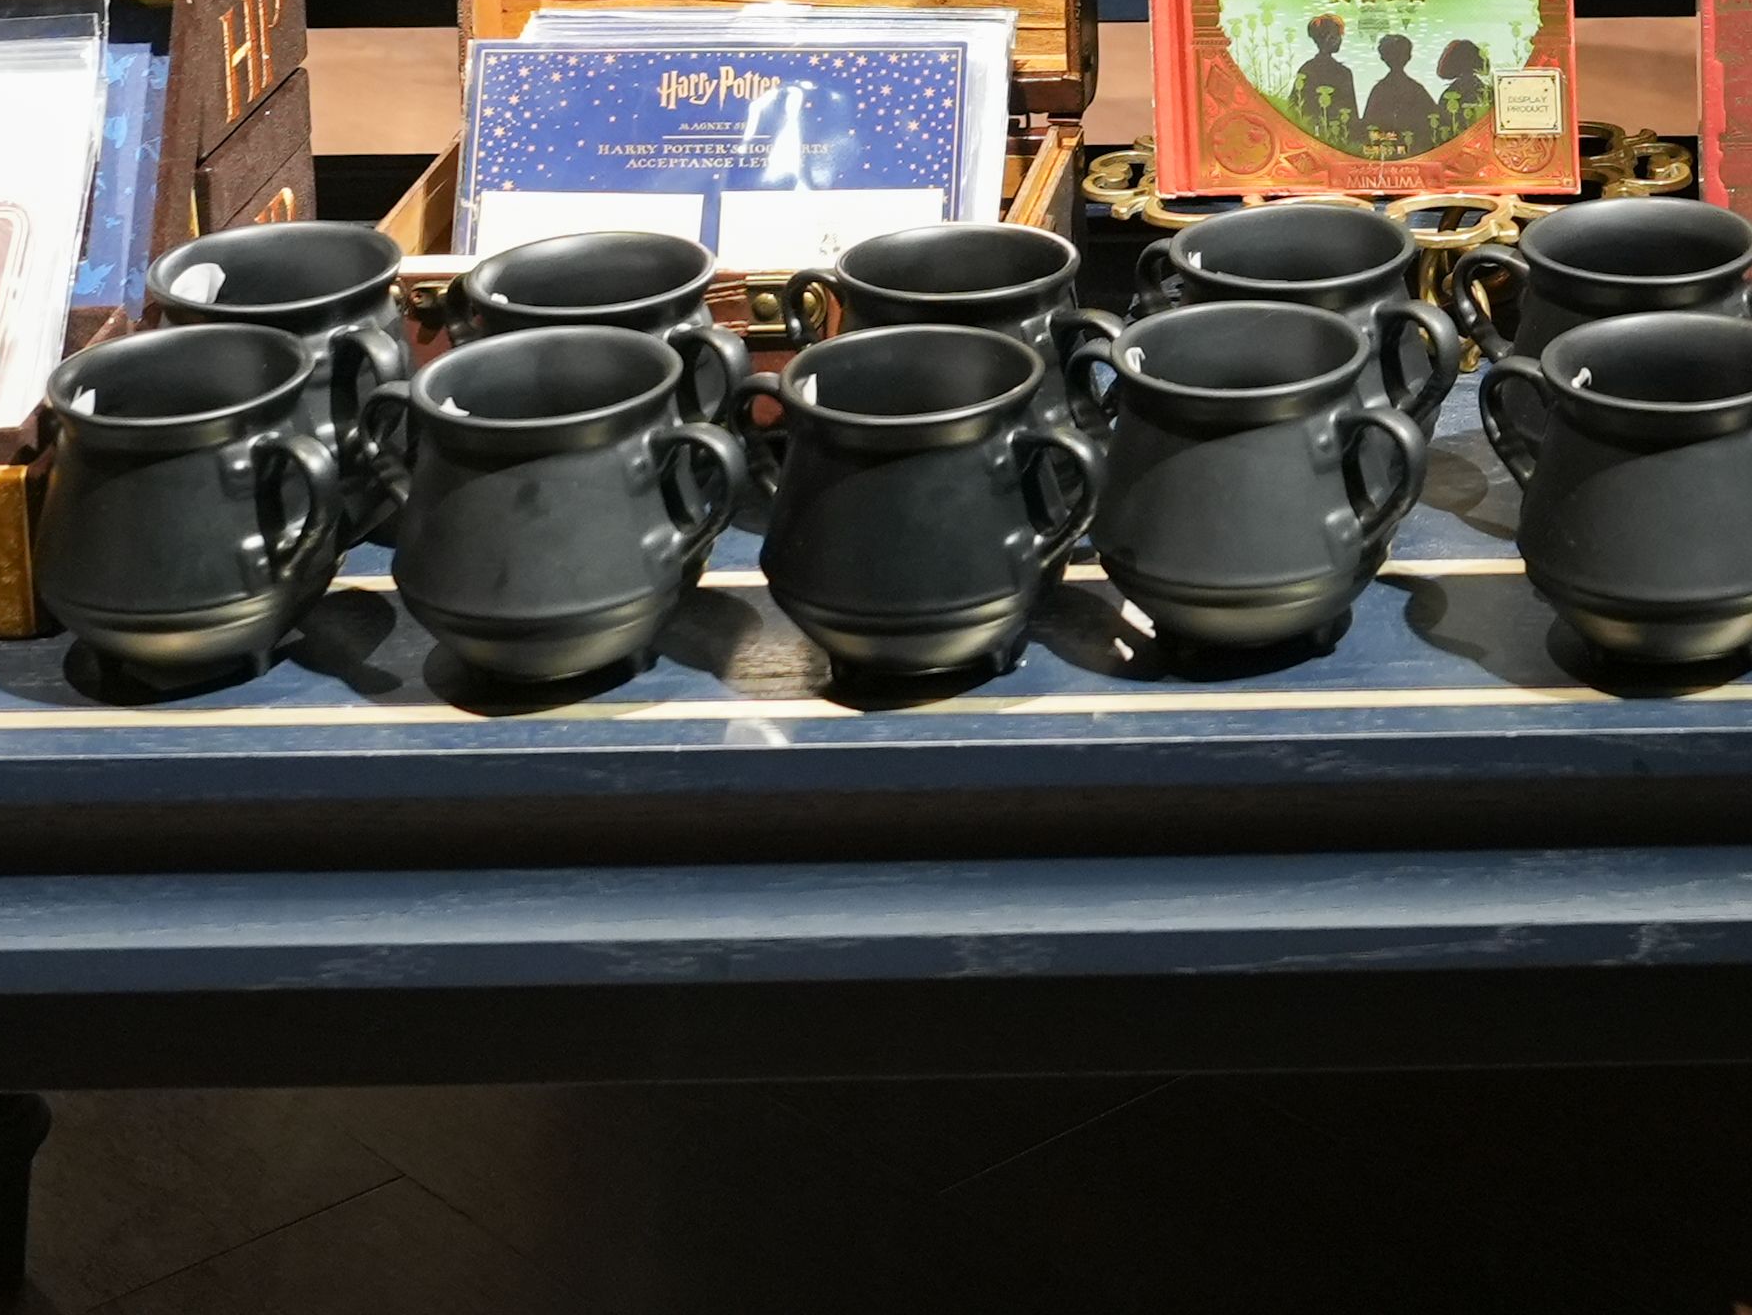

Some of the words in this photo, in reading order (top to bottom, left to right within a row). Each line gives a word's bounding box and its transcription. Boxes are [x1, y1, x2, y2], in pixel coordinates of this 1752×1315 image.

[658, 69, 719, 110] Harry
[719, 65, 781, 112] Potter
[1507, 94, 1548, 104] DISPLAY
[1506, 105, 1549, 114] PRODUCT
[678, 122, 732, 131] MAGNET
[597, 143, 658, 156] HARRY
[663, 143, 739, 155] POTTER'S
[625, 157, 734, 169] ACCEPTANCE
[1348, 175, 1426, 189] MINALIMA
